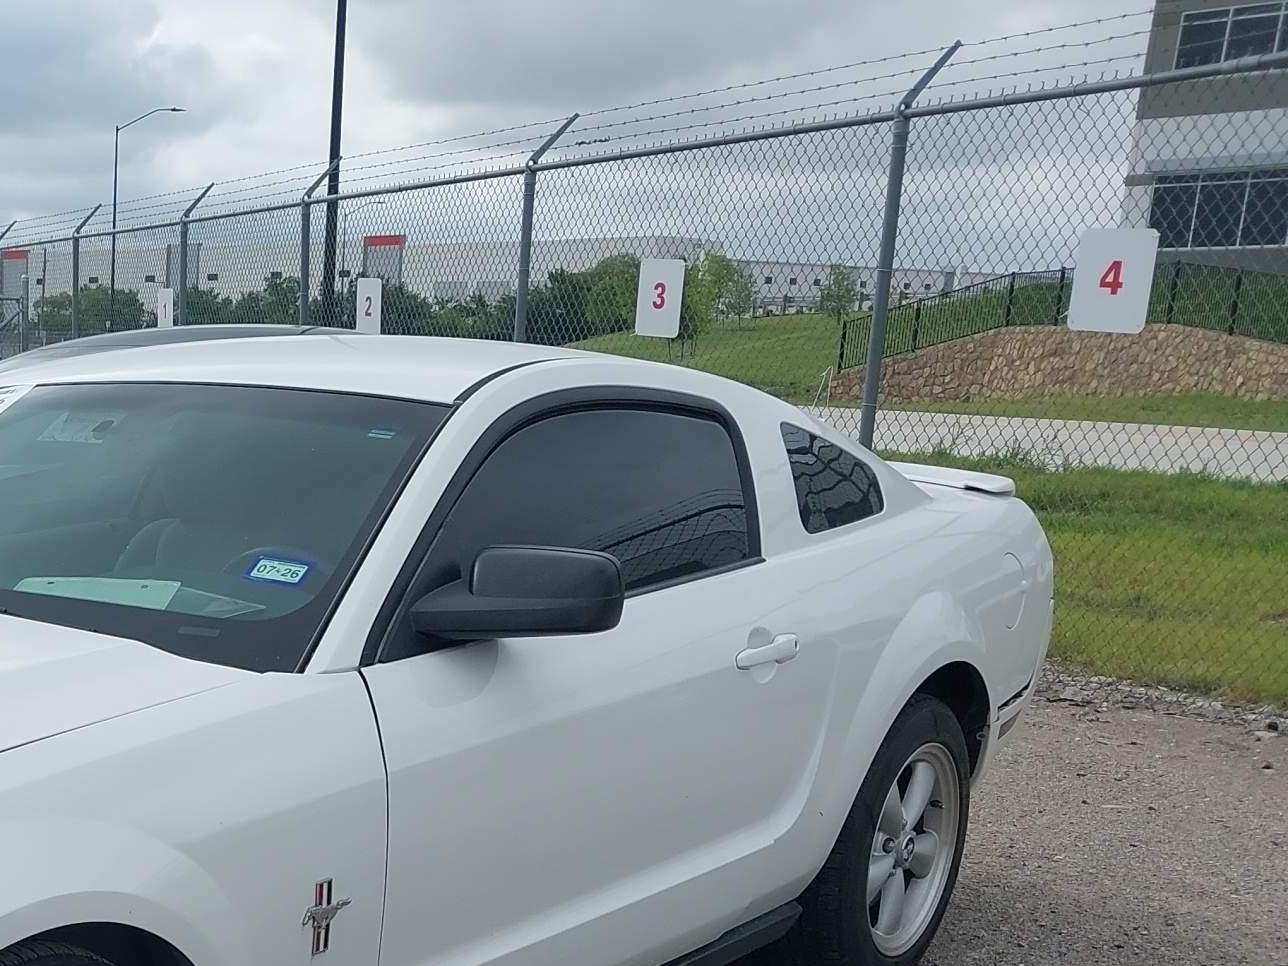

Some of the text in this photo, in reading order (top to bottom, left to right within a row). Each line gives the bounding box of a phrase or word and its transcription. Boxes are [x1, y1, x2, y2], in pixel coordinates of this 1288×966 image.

[1099, 260, 1124, 295] 4
[365, 296, 373, 317] 2
[651, 282, 667, 309] 3
